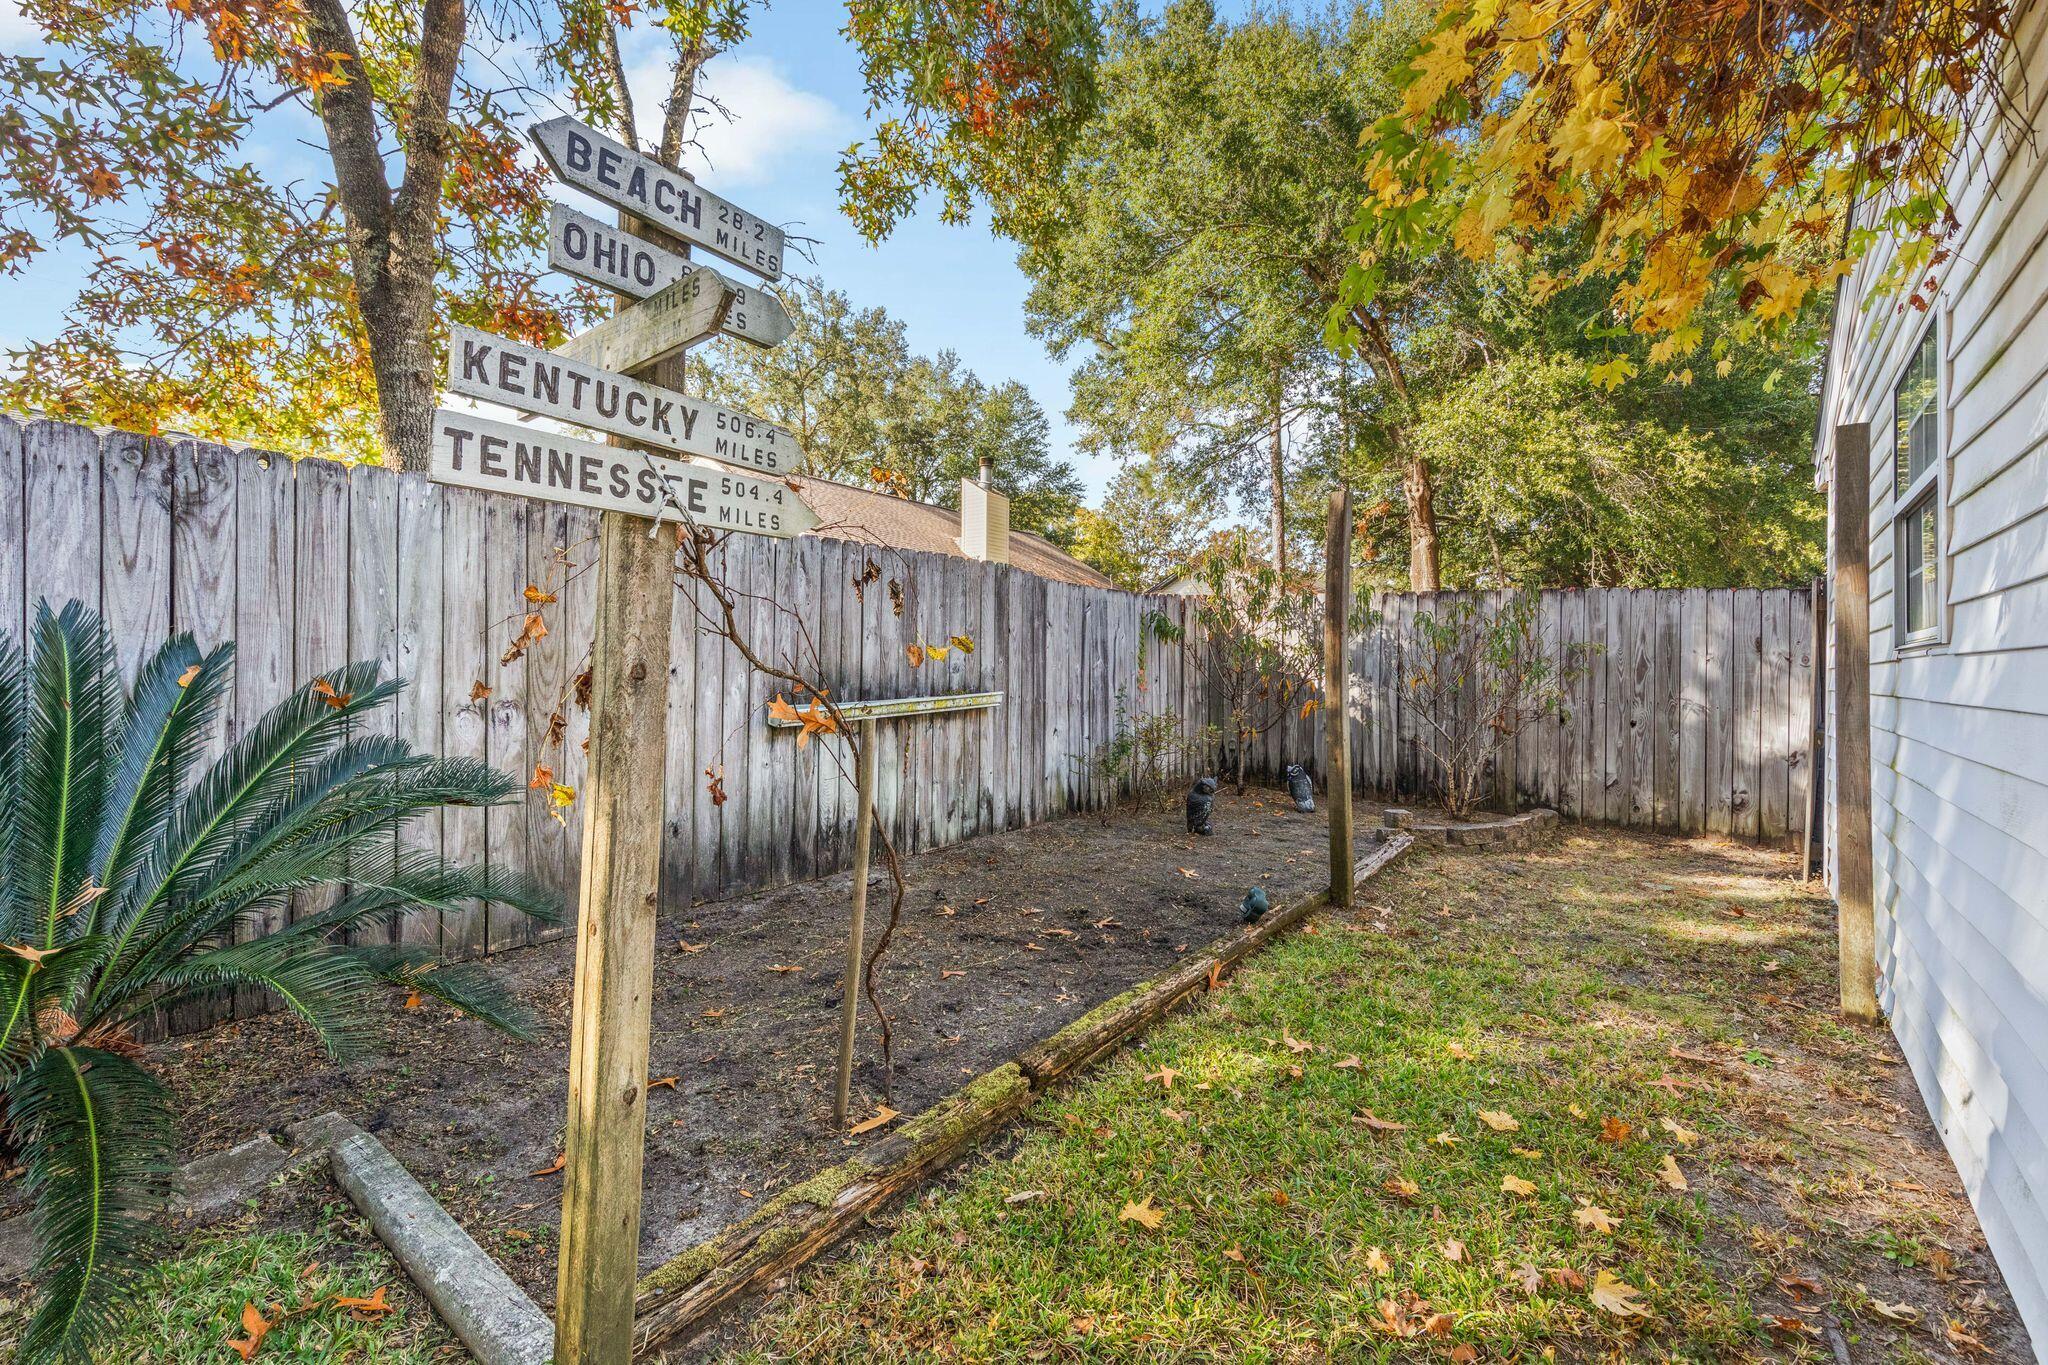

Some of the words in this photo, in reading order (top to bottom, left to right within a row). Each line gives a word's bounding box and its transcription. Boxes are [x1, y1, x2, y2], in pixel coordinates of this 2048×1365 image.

[567, 130, 702, 230] BEACH
[718, 205, 765, 242] 28.2
[563, 223, 656, 287] OHIO
[716, 232, 778, 273] MILES
[653, 276, 701, 315] MILES
[463, 340, 699, 441] KENTUCKY
[716, 412, 776, 444] 506.4
[716, 437, 777, 468] MILES
[721, 477, 783, 505] 504.4
[719, 506, 780, 530] MILES
